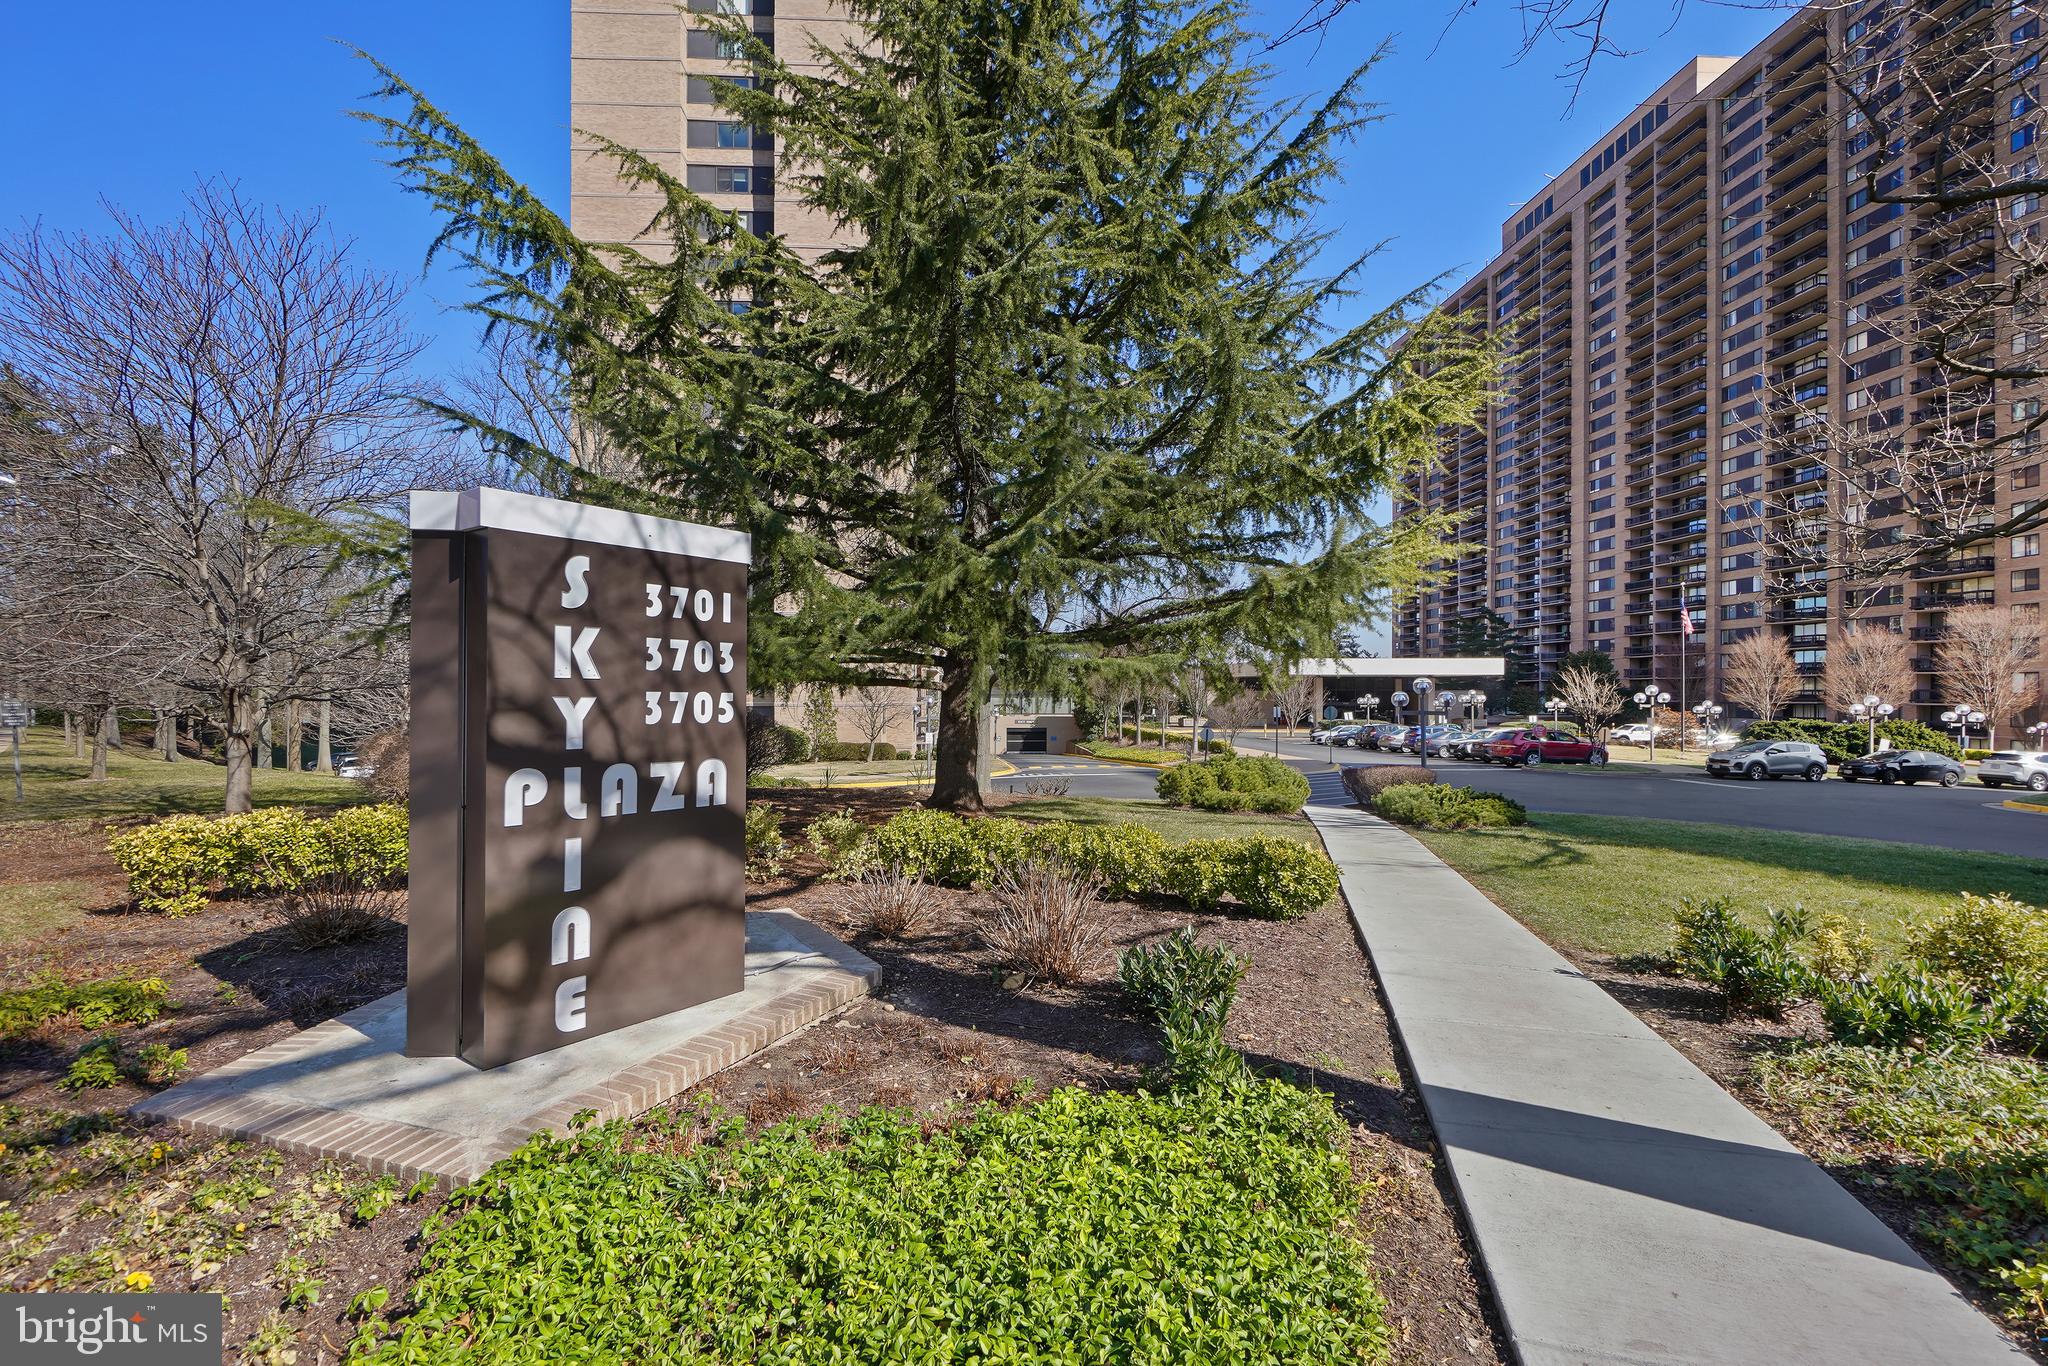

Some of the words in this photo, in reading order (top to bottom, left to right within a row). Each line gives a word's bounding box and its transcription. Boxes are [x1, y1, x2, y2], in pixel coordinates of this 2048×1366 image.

[645, 583, 732, 624] 3701
[645, 637, 735, 674] 3703
[645, 691, 735, 725] 3705
[503, 758, 728, 828] PLAZA
[551, 555, 600, 1033] SKYLINE
